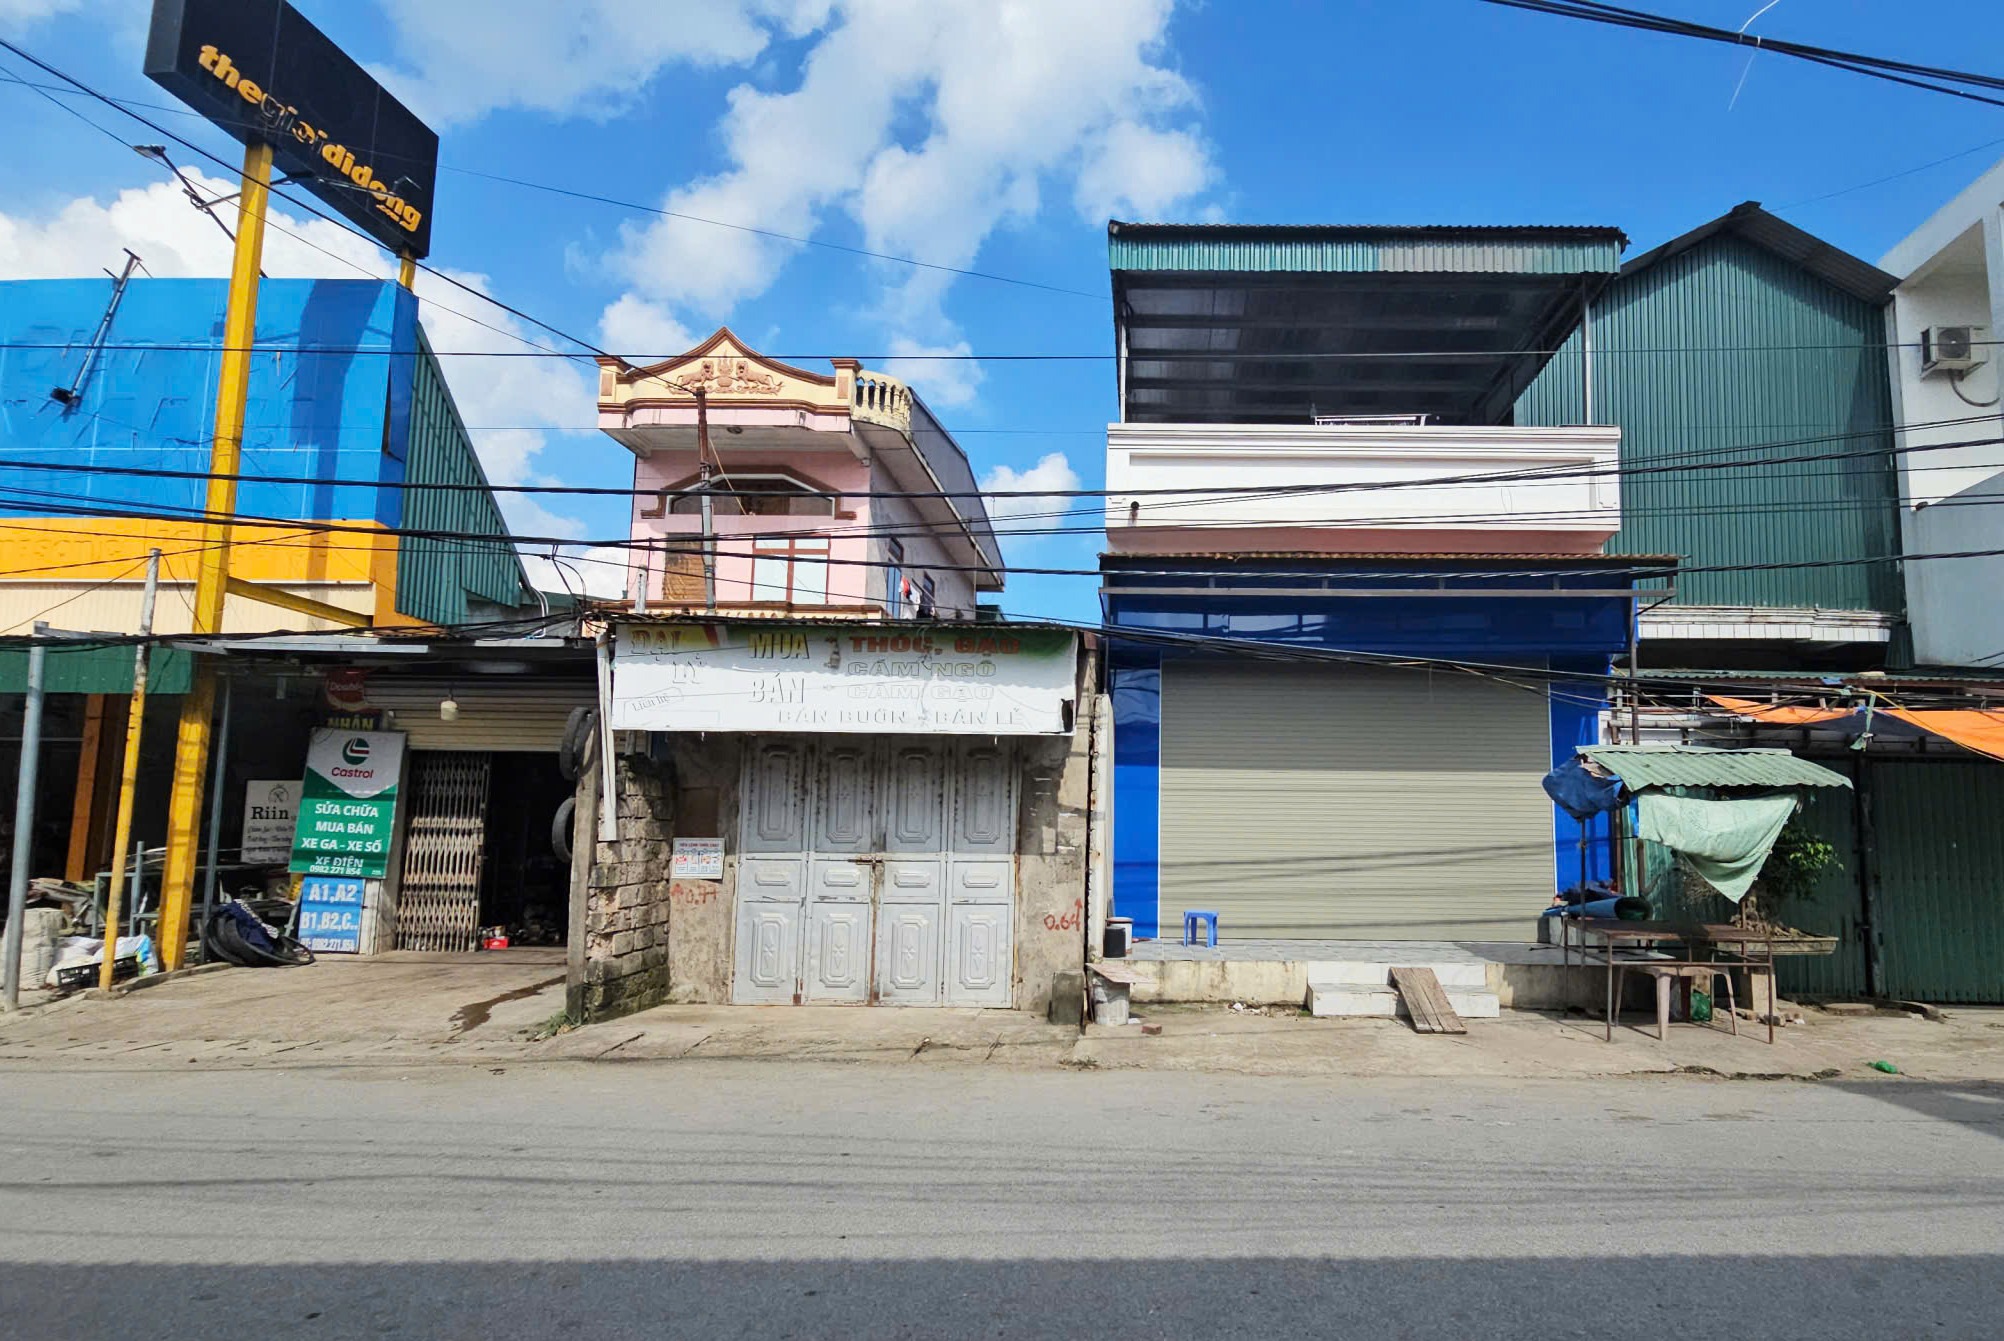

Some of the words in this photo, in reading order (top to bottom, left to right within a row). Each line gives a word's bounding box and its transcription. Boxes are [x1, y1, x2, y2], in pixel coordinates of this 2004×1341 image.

[748, 631, 810, 660] MUA
[954, 636, 1020, 657] GẠO
[748, 672, 805, 704] BÁN
[331, 767, 373, 778] Castrol
[251, 806, 289, 819] Riin
[315, 801, 340, 815] SỬA
[343, 804, 379, 817] CHỮA
[315, 821, 344, 833] MUA
[347, 821, 374, 834] BÁN
[301, 838, 318, 848] XE
[320, 839, 338, 849] GA
[347, 840, 363, 851] XE
[364, 839, 383, 853] SỐ
